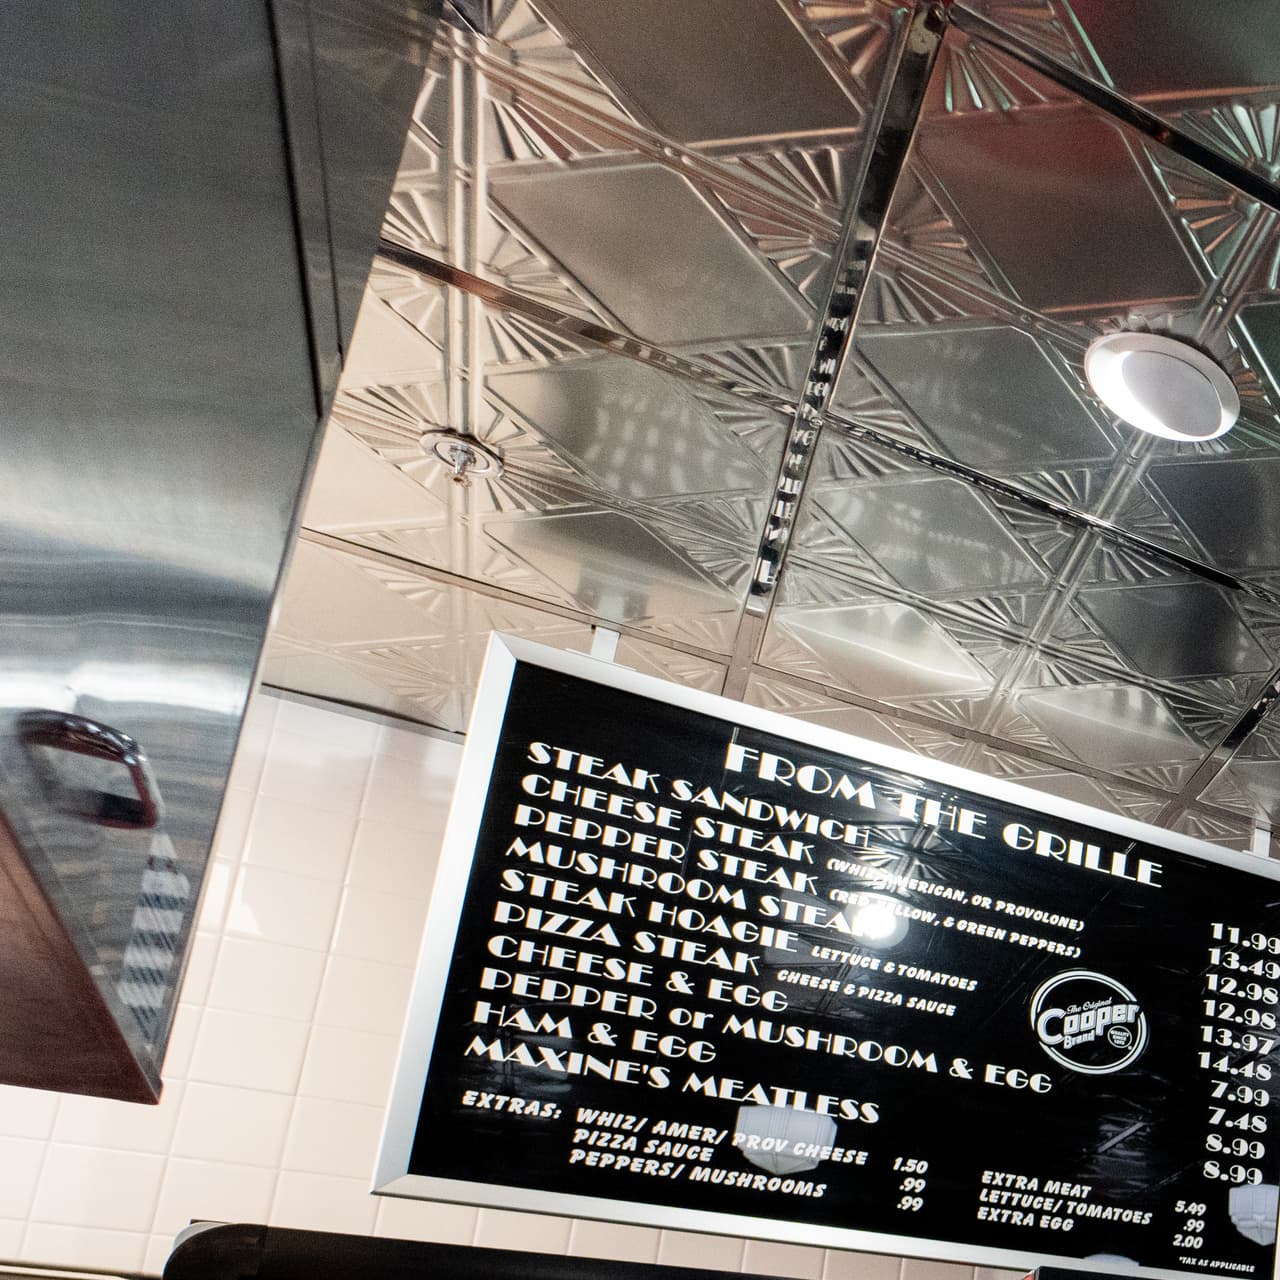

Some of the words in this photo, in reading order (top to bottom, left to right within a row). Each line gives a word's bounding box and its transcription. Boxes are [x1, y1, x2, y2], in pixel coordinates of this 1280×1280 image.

[527, 742, 660, 793] STEAK
[672, 778, 872, 849] SANDWICH
[521, 774, 683, 830] CHEESE
[694, 817, 816, 864] STEAK
[725, 743, 877, 809] FROM
[899, 792, 986, 841] THE
[1003, 823, 1163, 888] GRILLE
[514, 804, 687, 863] PEPPER
[697, 849, 818, 896] STEAK
[505, 837, 747, 911] MUSHROOM
[758, 895, 885, 941] STEA
[501, 868, 638, 918] STEAK
[647, 901, 799, 953] HOAGIE
[494, 901, 620, 948] PIZZA
[633, 931, 760, 976] STEAK
[488, 935, 654, 987] CHEESE
[666, 971, 695, 996] &
[708, 979, 789, 1013] EGG
[811, 946, 881, 973] LETTUCE
[883, 964, 895, 976] &
[897, 965, 978, 993] TOMATOES
[1208, 948, 1280, 980] 13.49
[777, 969, 841, 994] CHEESE
[843, 981, 856, 995] &
[858, 986, 904, 1006] PIZZA
[906, 996, 956, 1017] SAUCE
[1205, 974, 1279, 1006] 12.98
[473, 1001, 574, 1040] HAM
[587, 1022, 619, 1048] &
[632, 1029, 717, 1064] EGG
[480, 967, 658, 1021] PEPPER
[668, 1006, 714, 1029] or
[722, 1015, 938, 1074] MUSHROOM
[949, 1058, 973, 1080] &
[984, 1064, 1053, 1093] EGG
[1037, 1004, 1140, 1045] Cooper
[1203, 1000, 1276, 1031] 12.98
[1201, 1025, 1274, 1055] 13.97
[464, 1035, 671, 1090] MAXINE'S
[682, 1072, 881, 1125] MEATLESS
[1198, 1052, 1272, 1082] 14.48
[1210, 1080, 1269, 1108] 7.99
[461, 1090, 563, 1121] EXTRAS:
[577, 1108, 647, 1133] WHIZ/
[652, 1119, 727, 1145] AMER/
[732, 1132, 789, 1155] PROV
[792, 1140, 869, 1166] CHEESE
[1208, 1106, 1267, 1134] 7.48
[572, 1129, 639, 1151] PIZZA
[644, 1139, 715, 1163] SAUCE
[1205, 1134, 1265, 1161] 8.99
[569, 1148, 684, 1180] PEPPERS/
[689, 1165, 828, 1198] MUSHROOMS
[893, 1156, 929, 1175] 1.50
[1203, 1161, 1262, 1186] 8.99
[898, 1175, 926, 1194] .99
[982, 1171, 1039, 1191] EXTRA
[1044, 1180, 1091, 1198] MEAT
[896, 1195, 923, 1213] .99
[977, 1207, 1034, 1227] EXTRA
[1039, 1215, 1074, 1232] EGG
[979, 1188, 1063, 1214] LETTUCE/
[1066, 1200, 1152, 1226] TOMATOES
[1174, 1200, 1206, 1217] 5.49
[1173, 1234, 1203, 1250] 2.00
[1183, 1218, 1205, 1233] .99
